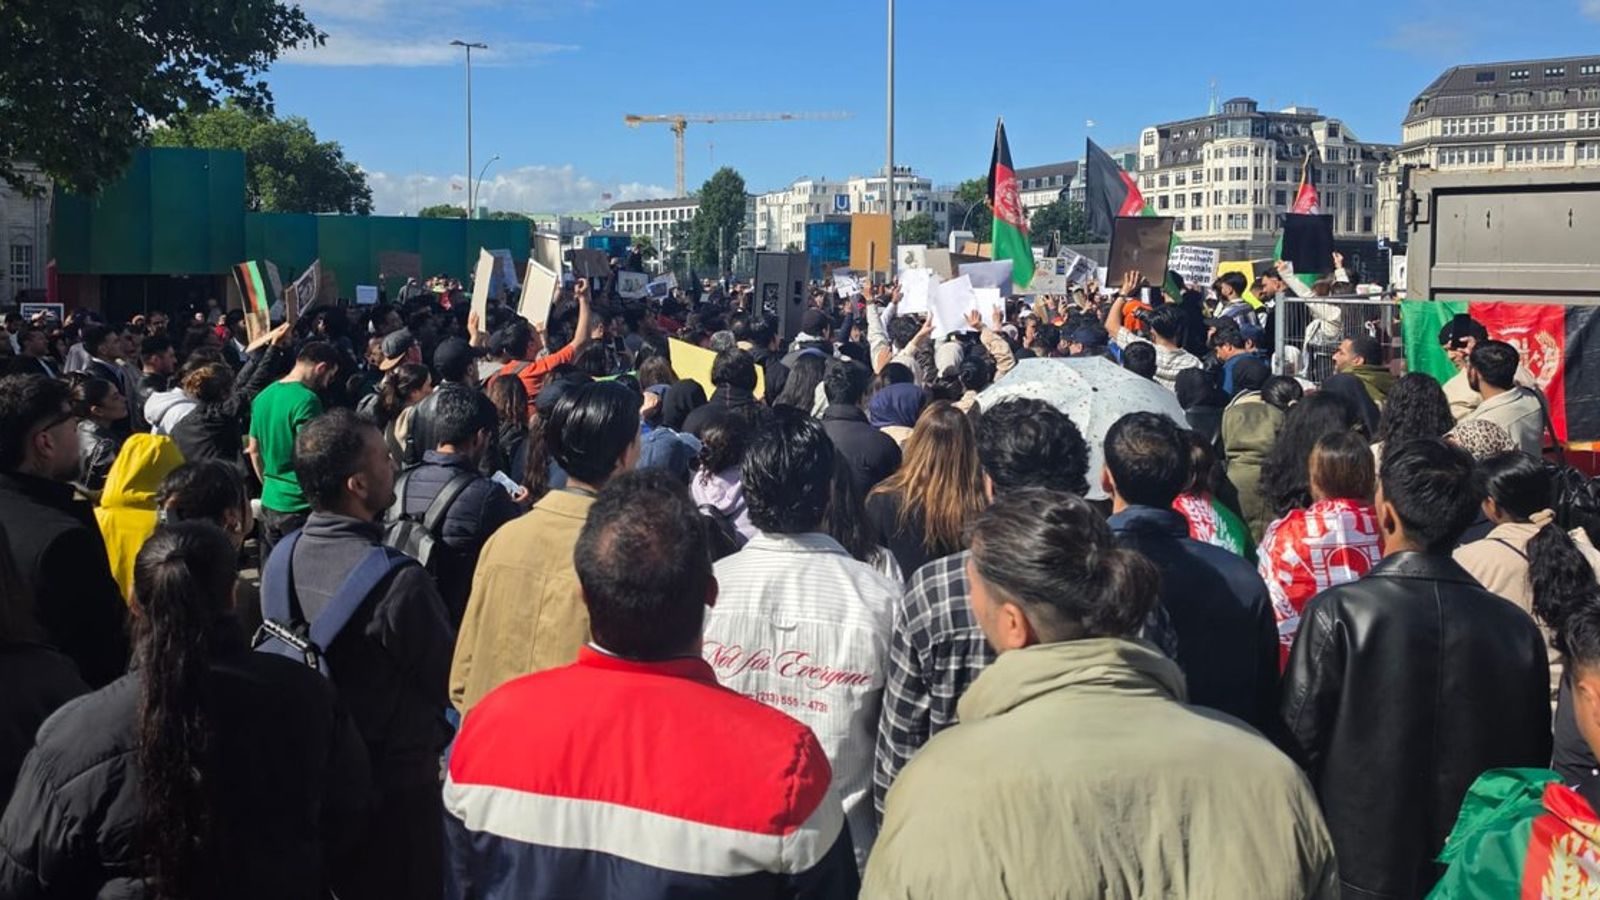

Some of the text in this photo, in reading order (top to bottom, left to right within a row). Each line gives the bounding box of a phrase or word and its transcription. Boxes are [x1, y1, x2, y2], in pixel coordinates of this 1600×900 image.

[836, 196, 848, 210] U
[603, 217, 612, 228] U
[1180, 247, 1214, 256] Stimme
[1180, 254, 1214, 264] Freiheit
[703, 641, 872, 690] Not for Everyone
